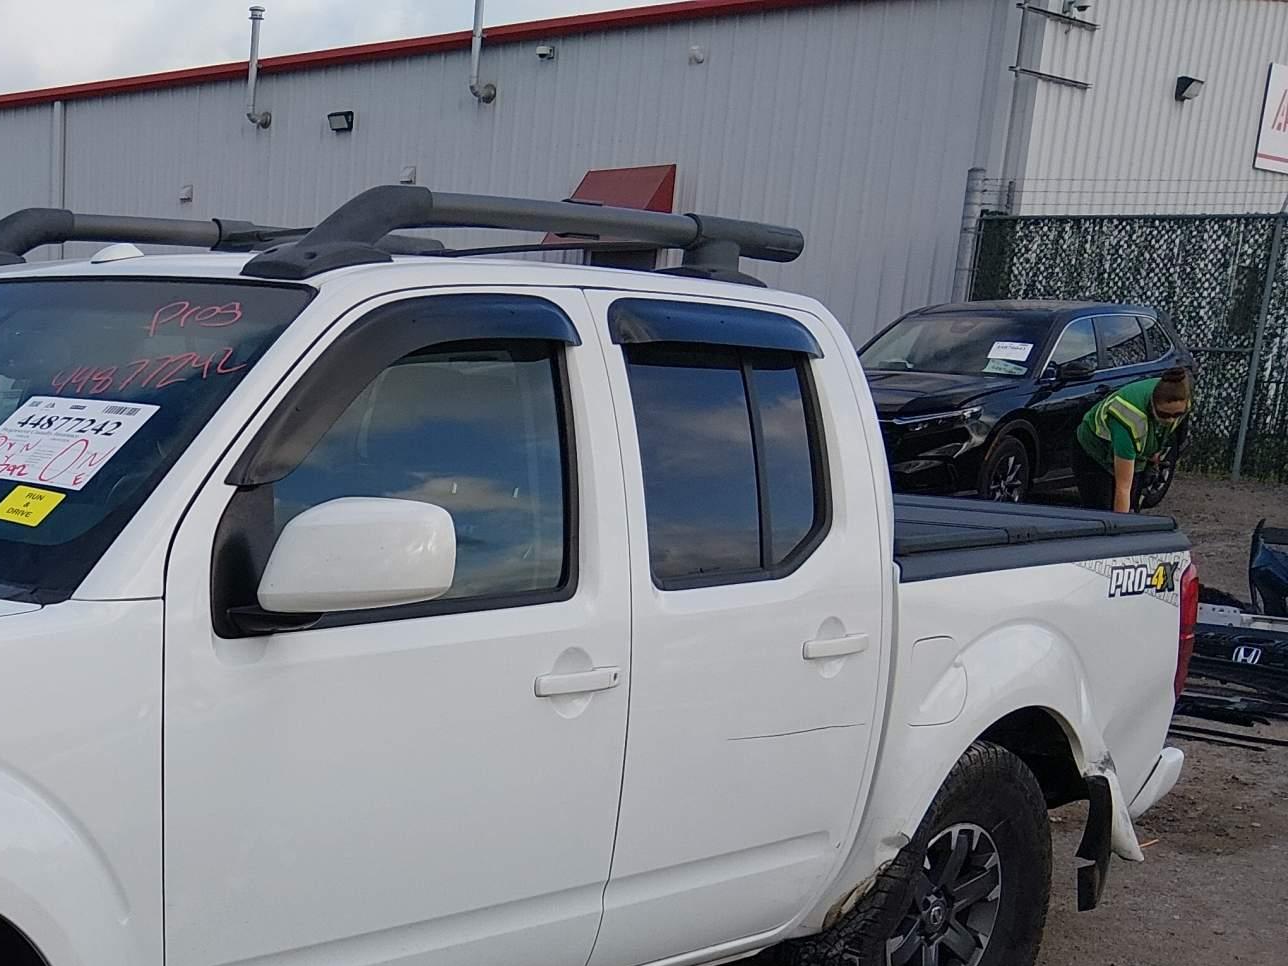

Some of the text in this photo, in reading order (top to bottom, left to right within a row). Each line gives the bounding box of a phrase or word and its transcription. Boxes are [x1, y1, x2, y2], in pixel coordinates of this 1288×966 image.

[50, 348, 247, 394] 44877242
[17, 413, 123, 436] 44877242
[25, 492, 45, 501] RUN
[6, 507, 32, 518] DRIVE
[1108, 561, 1179, 598] PRO-4X
